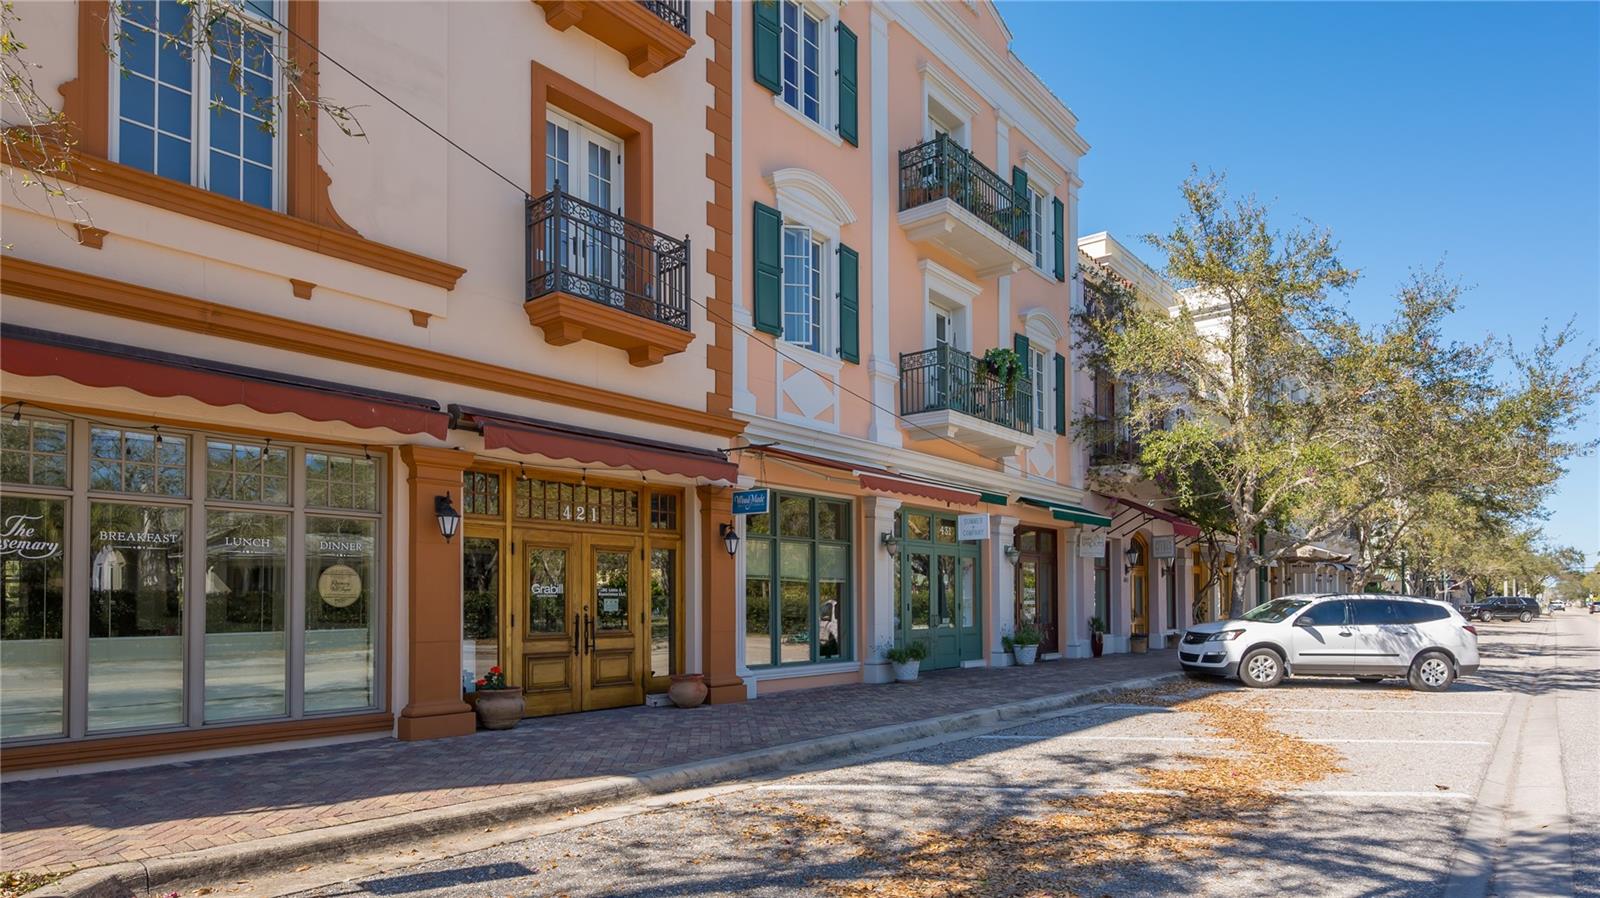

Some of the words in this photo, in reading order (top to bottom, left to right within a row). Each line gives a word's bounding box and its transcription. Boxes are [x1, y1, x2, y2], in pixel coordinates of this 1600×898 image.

[562, 504, 597, 522] 421
[0, 515, 44, 537] The
[99, 530, 178, 544] BREAKFAST
[225, 536, 270, 548] LUNCH
[0, 538, 59, 559] semary
[320, 541, 362, 551] DINNER
[531, 583, 564, 594] Grabill
